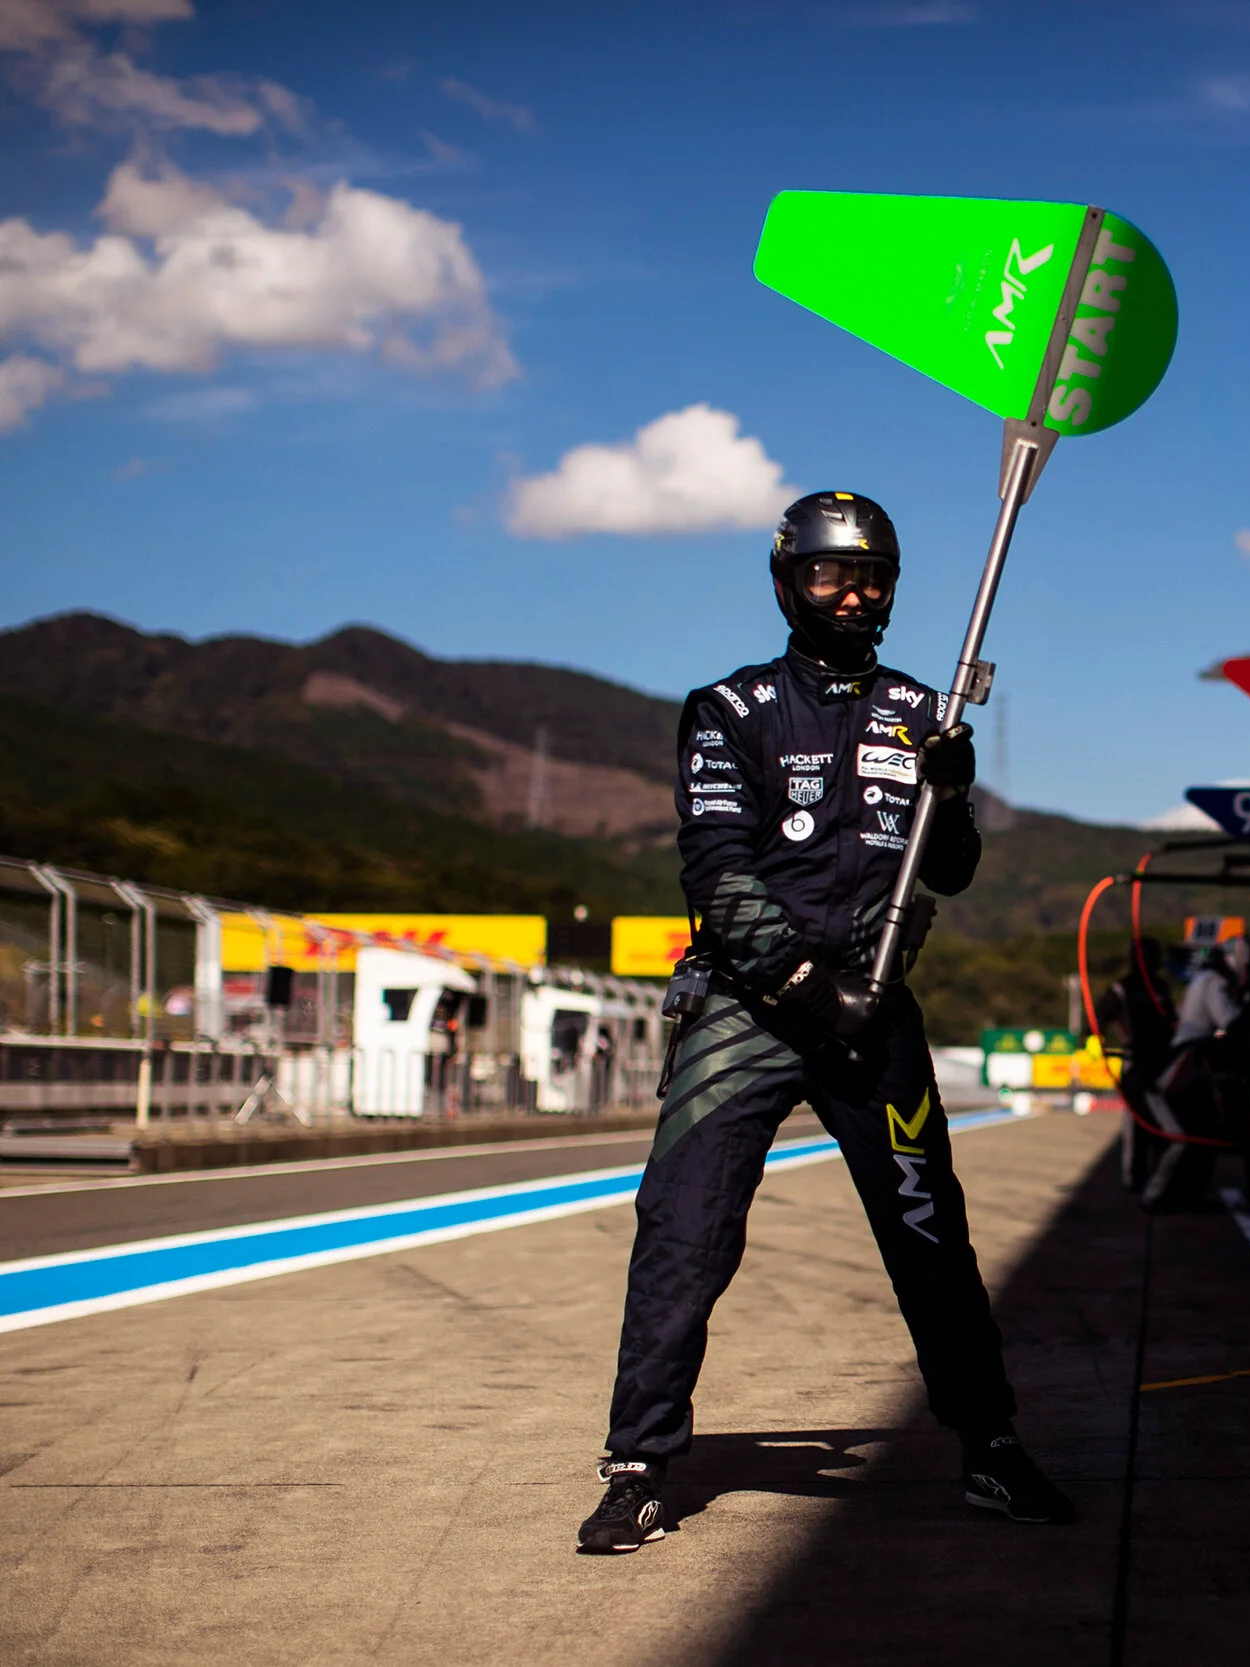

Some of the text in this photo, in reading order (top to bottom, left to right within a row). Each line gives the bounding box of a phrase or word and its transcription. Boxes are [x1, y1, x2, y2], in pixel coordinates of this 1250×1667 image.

[985, 237, 1054, 370] AMR
[1047, 228, 1136, 427] START
[825, 682, 861, 695] AMR
[888, 685, 925, 708] sky
[865, 720, 912, 745] AMR
[705, 759, 738, 770] TOTAL
[779, 753, 834, 767] HACKETT
[861, 751, 915, 769] WEC
[793, 780, 820, 789] TAG
[791, 791, 821, 804] HEUER
[884, 792, 912, 807] TOTAL
[886, 1086, 940, 1244] AMR
